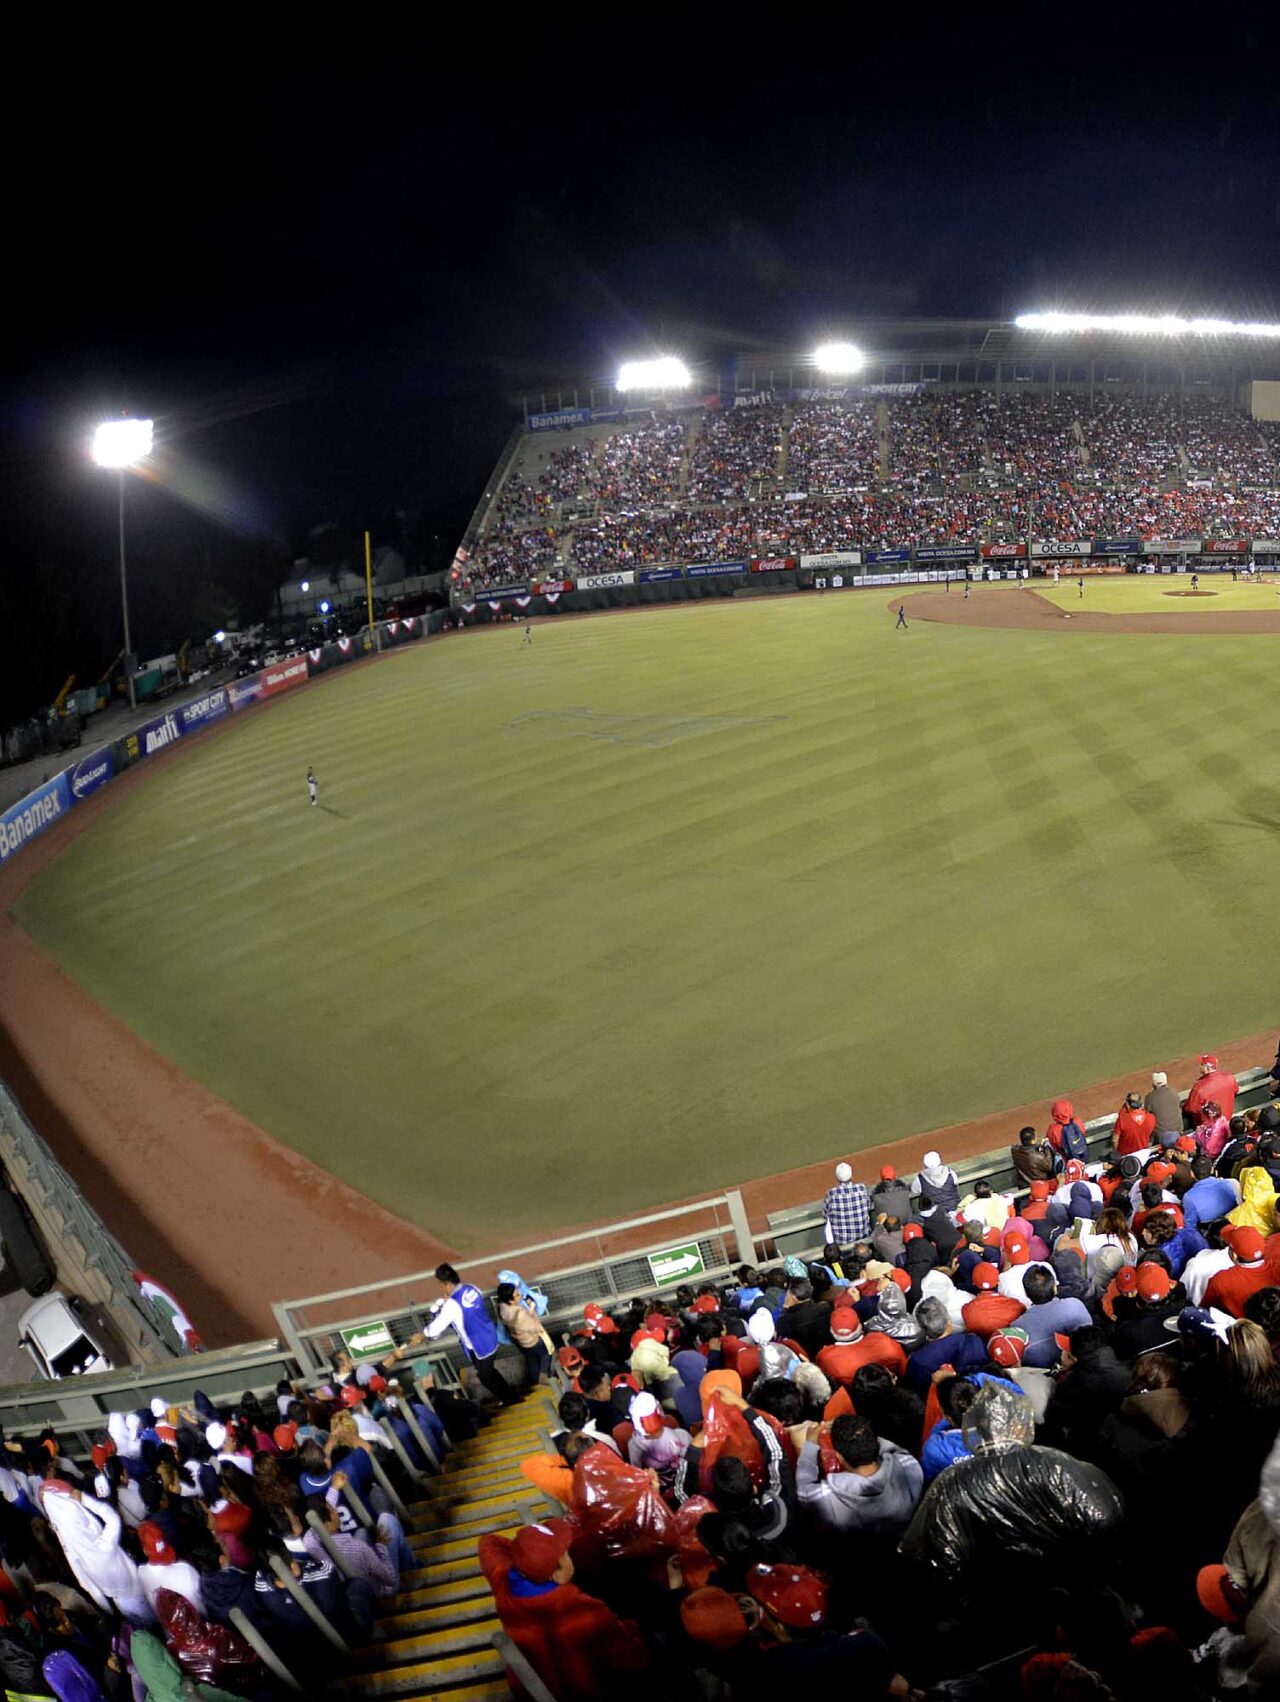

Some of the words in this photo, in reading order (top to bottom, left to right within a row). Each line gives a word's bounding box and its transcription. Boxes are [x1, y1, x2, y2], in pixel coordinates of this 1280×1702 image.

[531, 413, 583, 429] Banamex
[1041, 544, 1081, 553] OCESA
[587, 575, 624, 588] OCESA
[0, 789, 61, 858] Banamex
